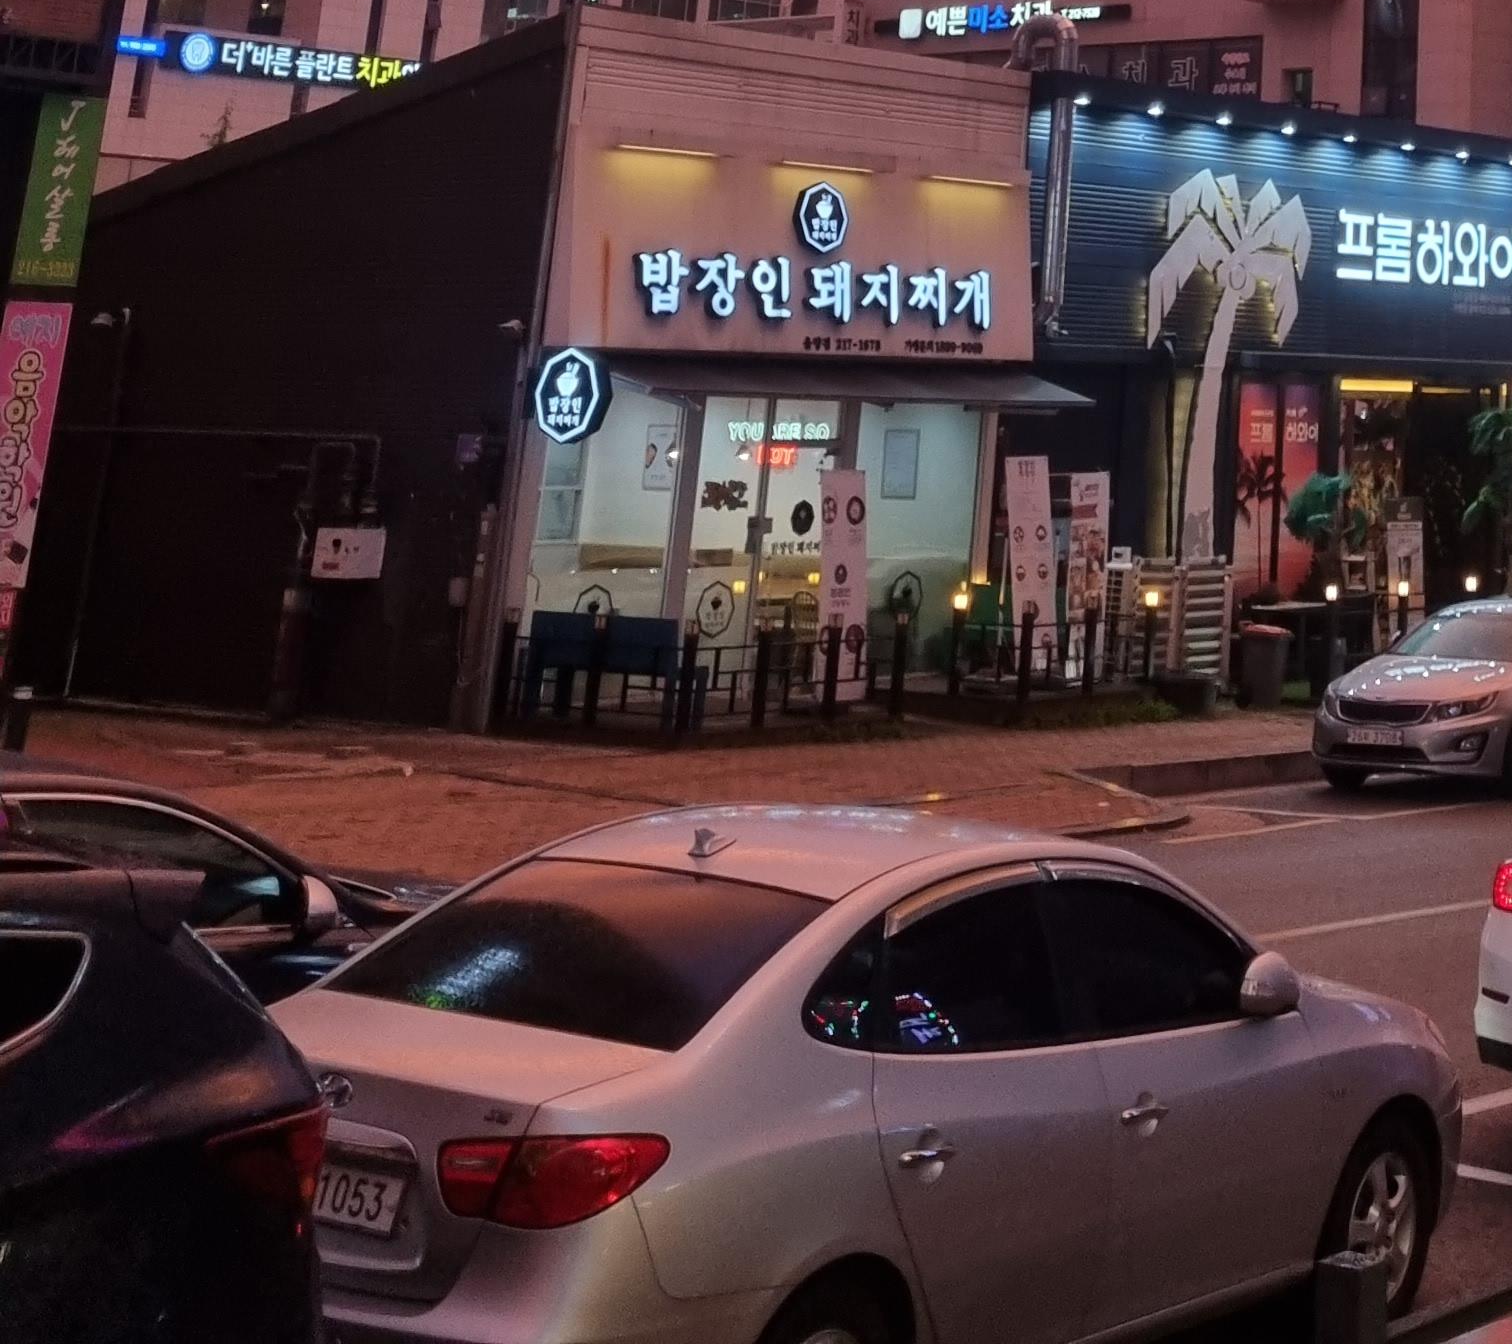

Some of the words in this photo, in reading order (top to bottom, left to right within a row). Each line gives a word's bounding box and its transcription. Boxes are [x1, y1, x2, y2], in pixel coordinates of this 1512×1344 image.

[640, 249, 792, 318] 밥장인
[809, 261, 993, 330] 돼지찌개
[548, 397, 582, 414] 밥장인
[728, 421, 765, 442] YOU
[803, 422, 830, 440] SO
[318, 1172, 387, 1222] 1053
